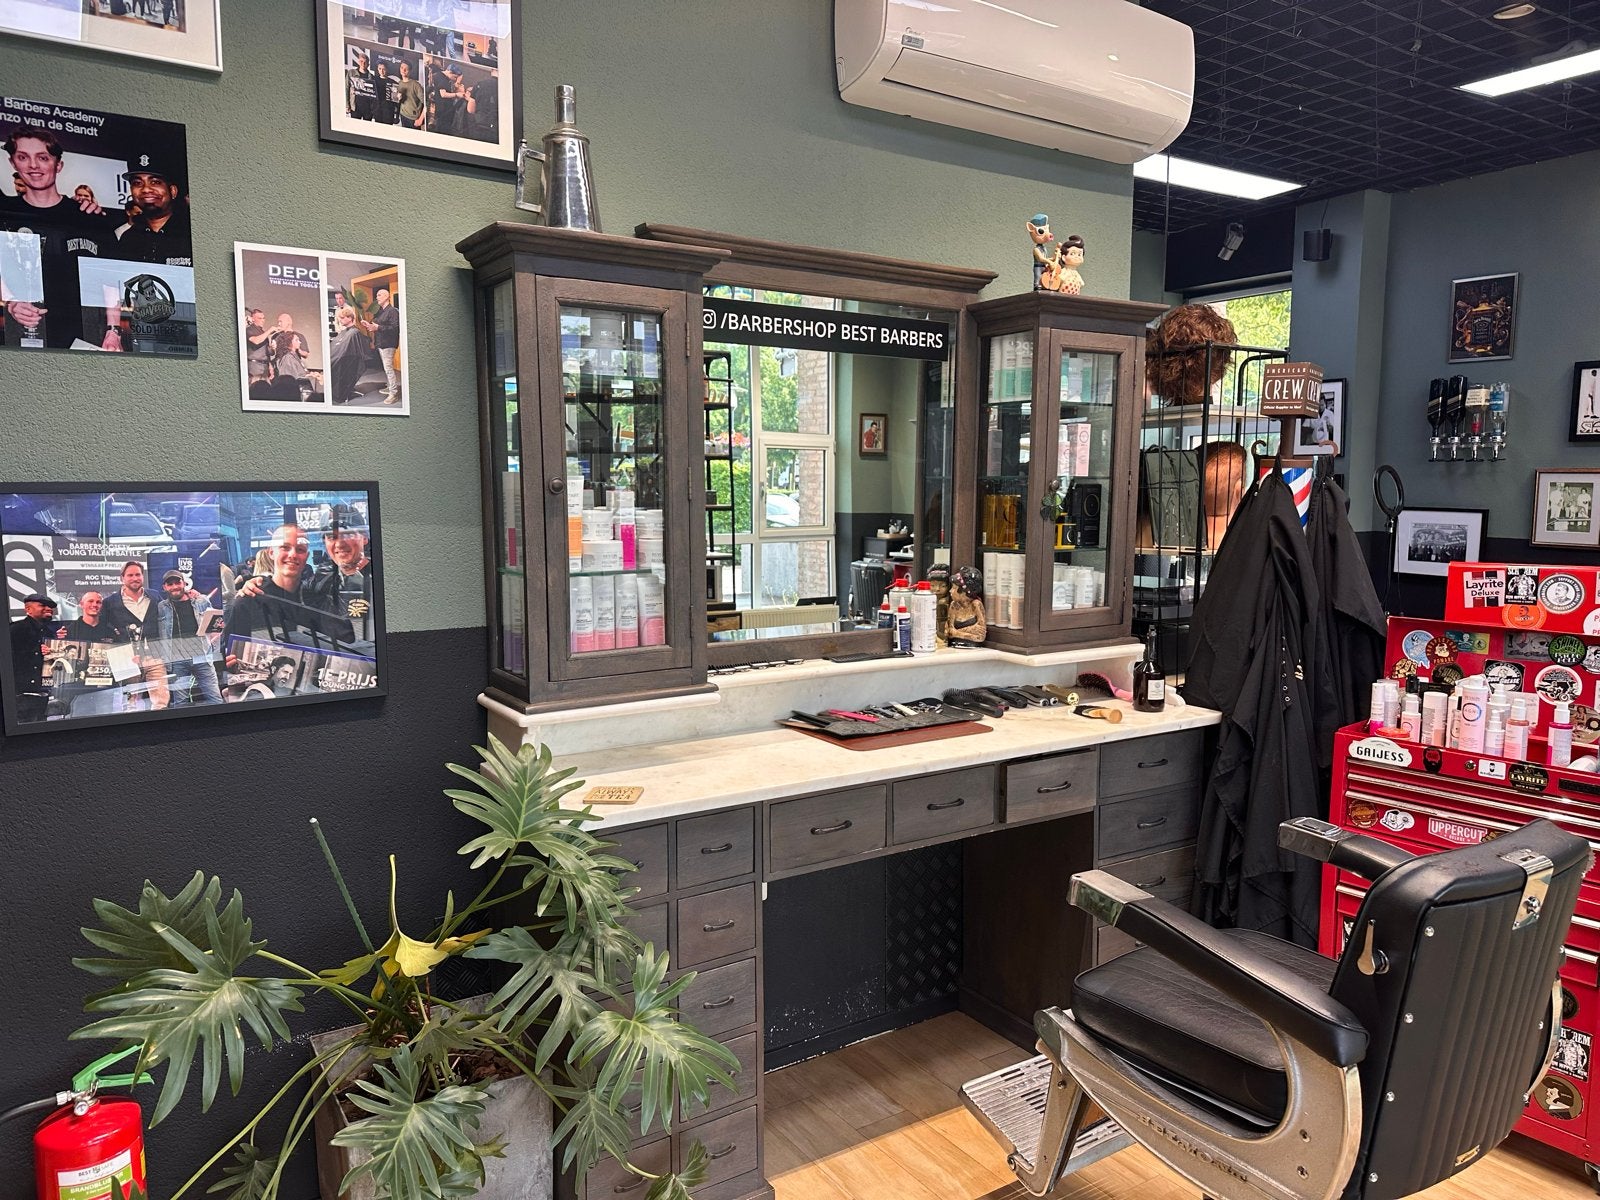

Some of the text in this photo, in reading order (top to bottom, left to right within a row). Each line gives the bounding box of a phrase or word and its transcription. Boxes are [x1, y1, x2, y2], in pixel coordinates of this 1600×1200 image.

[3, 97, 105, 127] Barbers Academy
[24, 116, 45, 128] van
[48, 120, 63, 131] de
[65, 122, 98, 137] Sandt
[131, 324, 153, 334] SOLD
[720, 312, 943, 349] /BARBERSHOP BEST BARBERS
[1507, 567, 1538, 576] SCHREM
[1466, 579, 1504, 590] Layrite
[337, 670, 378, 688] PRIJS
[1356, 746, 1404, 763] GAIJESS
[1510, 773, 1547, 785] LAYRITE
[1431, 820, 1485, 840] UPPERCUT
